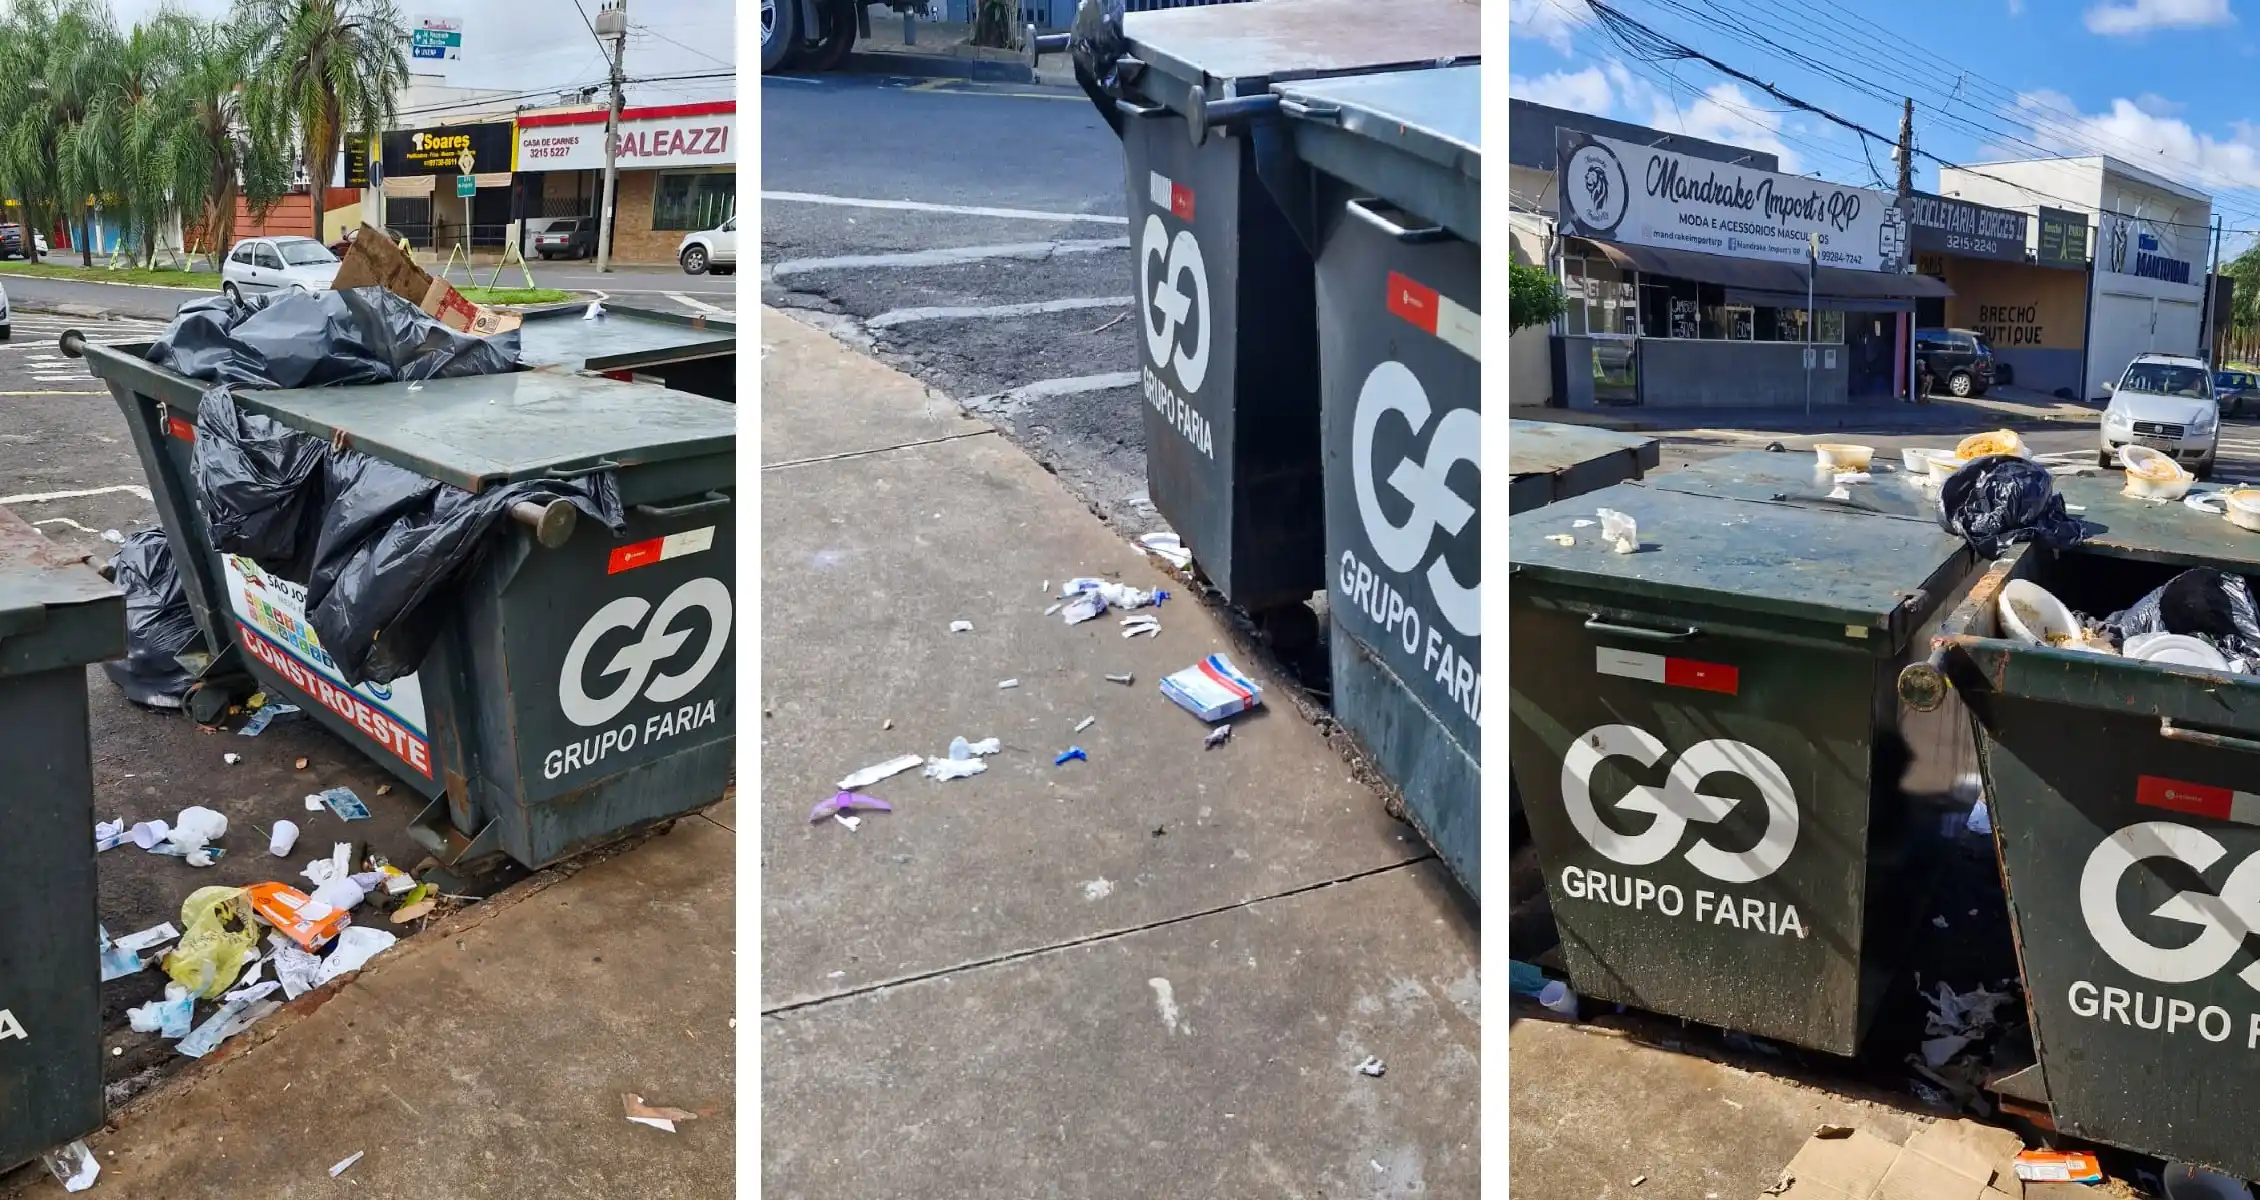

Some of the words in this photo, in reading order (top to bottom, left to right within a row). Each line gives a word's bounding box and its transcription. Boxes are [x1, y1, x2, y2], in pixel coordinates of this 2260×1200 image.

[424, 133, 470, 150] Soares
[523, 138, 541, 147] CASA
[541, 138, 551, 146] DE
[552, 136, 579, 145] CARNES
[530, 149, 548, 158] 3215
[550, 147, 570, 157] 5227
[1646, 155, 1754, 210] Mandrake
[1827, 190, 1860, 232] RP
[1979, 210, 2015, 239] BORGES
[1679, 212, 1709, 228] MODA
[1711, 218, 1718, 229] E
[1777, 227, 1830, 245] MASCULOS
[1144, 364, 1175, 425] GRUPO
[1176, 402, 1214, 460] FARIA
[291, 587, 306, 603] JO
[1340, 550, 1420, 655] GRUPO
[1424, 627, 1481, 727] FARI
[241, 627, 428, 772] CONSTROESTE
[544, 723, 637, 779] GRUPO
[643, 699, 716, 744] FARIA
[1561, 866, 1684, 916] GRUPO
[1696, 889, 1805, 939] FARIA
[2068, 980, 2231, 1042] GRUPO
